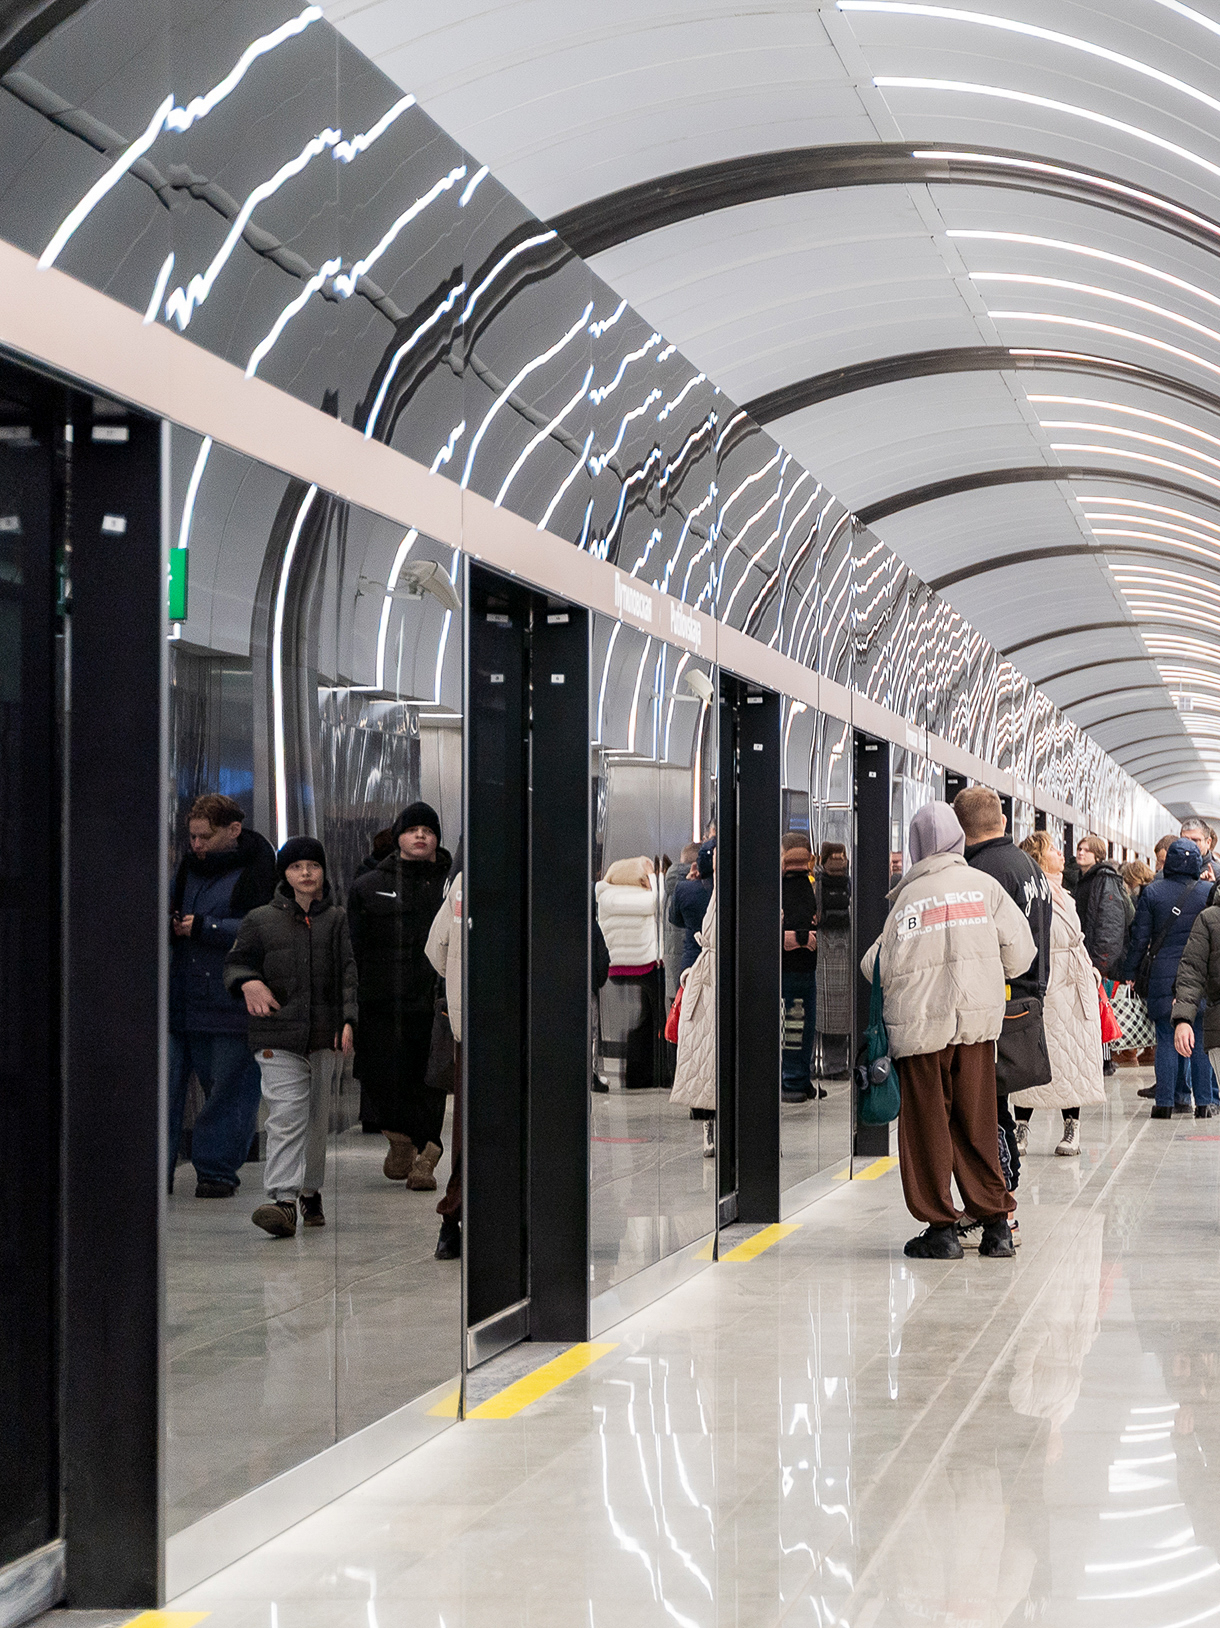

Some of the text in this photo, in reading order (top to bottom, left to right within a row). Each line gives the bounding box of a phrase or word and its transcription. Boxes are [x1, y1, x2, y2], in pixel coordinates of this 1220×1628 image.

[897, 925, 933, 942] WORLD
[959, 916, 988, 926] MADE
[908, 916, 917, 930] B
